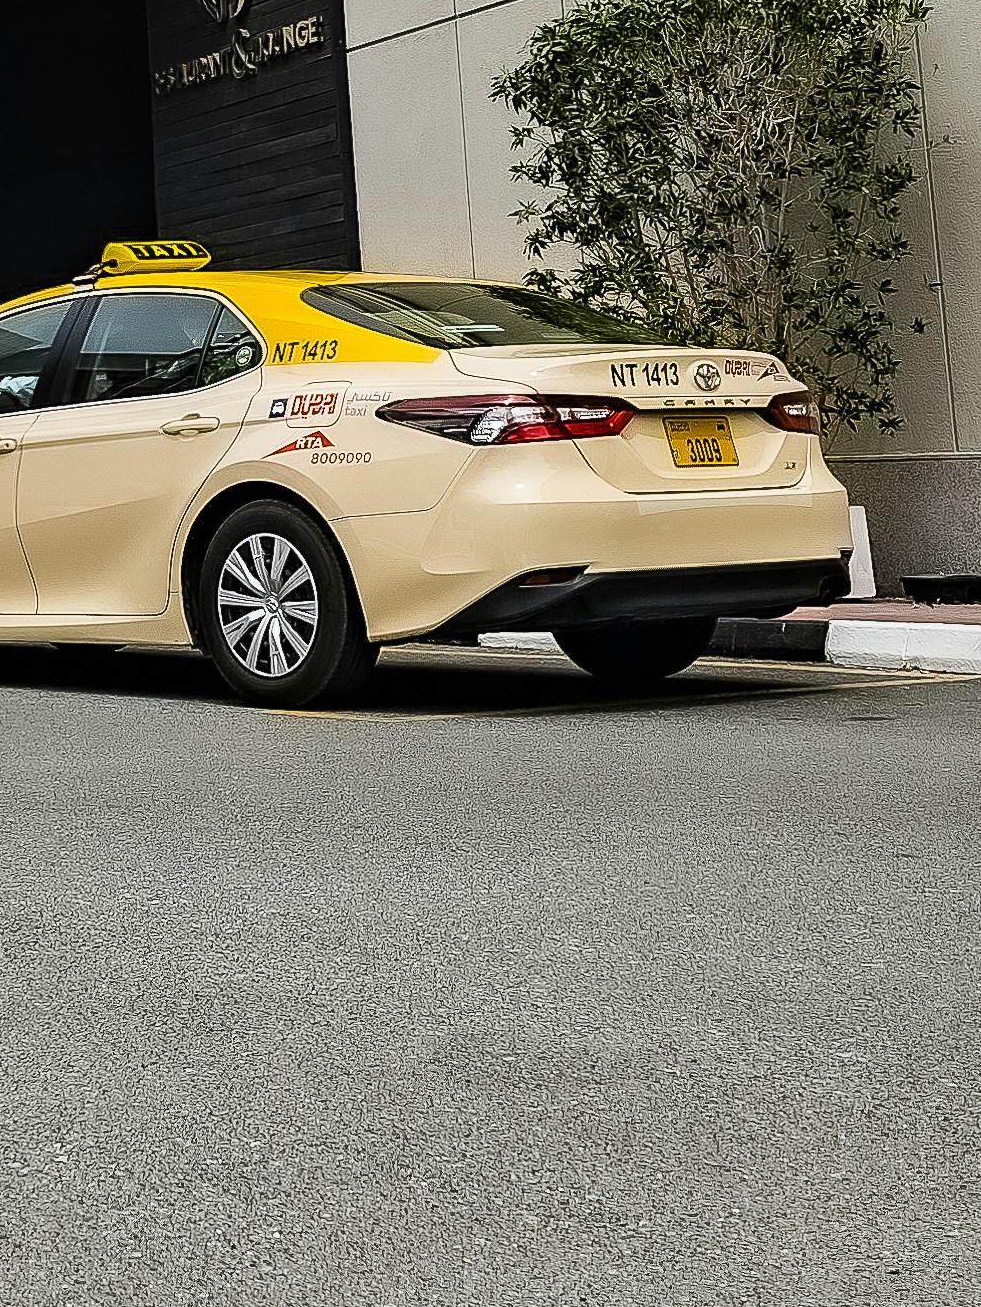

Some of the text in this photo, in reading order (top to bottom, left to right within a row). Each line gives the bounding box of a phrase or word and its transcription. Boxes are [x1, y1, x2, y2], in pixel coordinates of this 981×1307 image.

[131, 243, 198, 257] TAXI
[272, 339, 339, 364] NT 1413
[610, 362, 680, 387] NT 1413
[344, 404, 368, 417] taxi
[295, 436, 324, 449] RTA
[687, 437, 723, 463] 3009
[310, 451, 372, 465] 8009090
